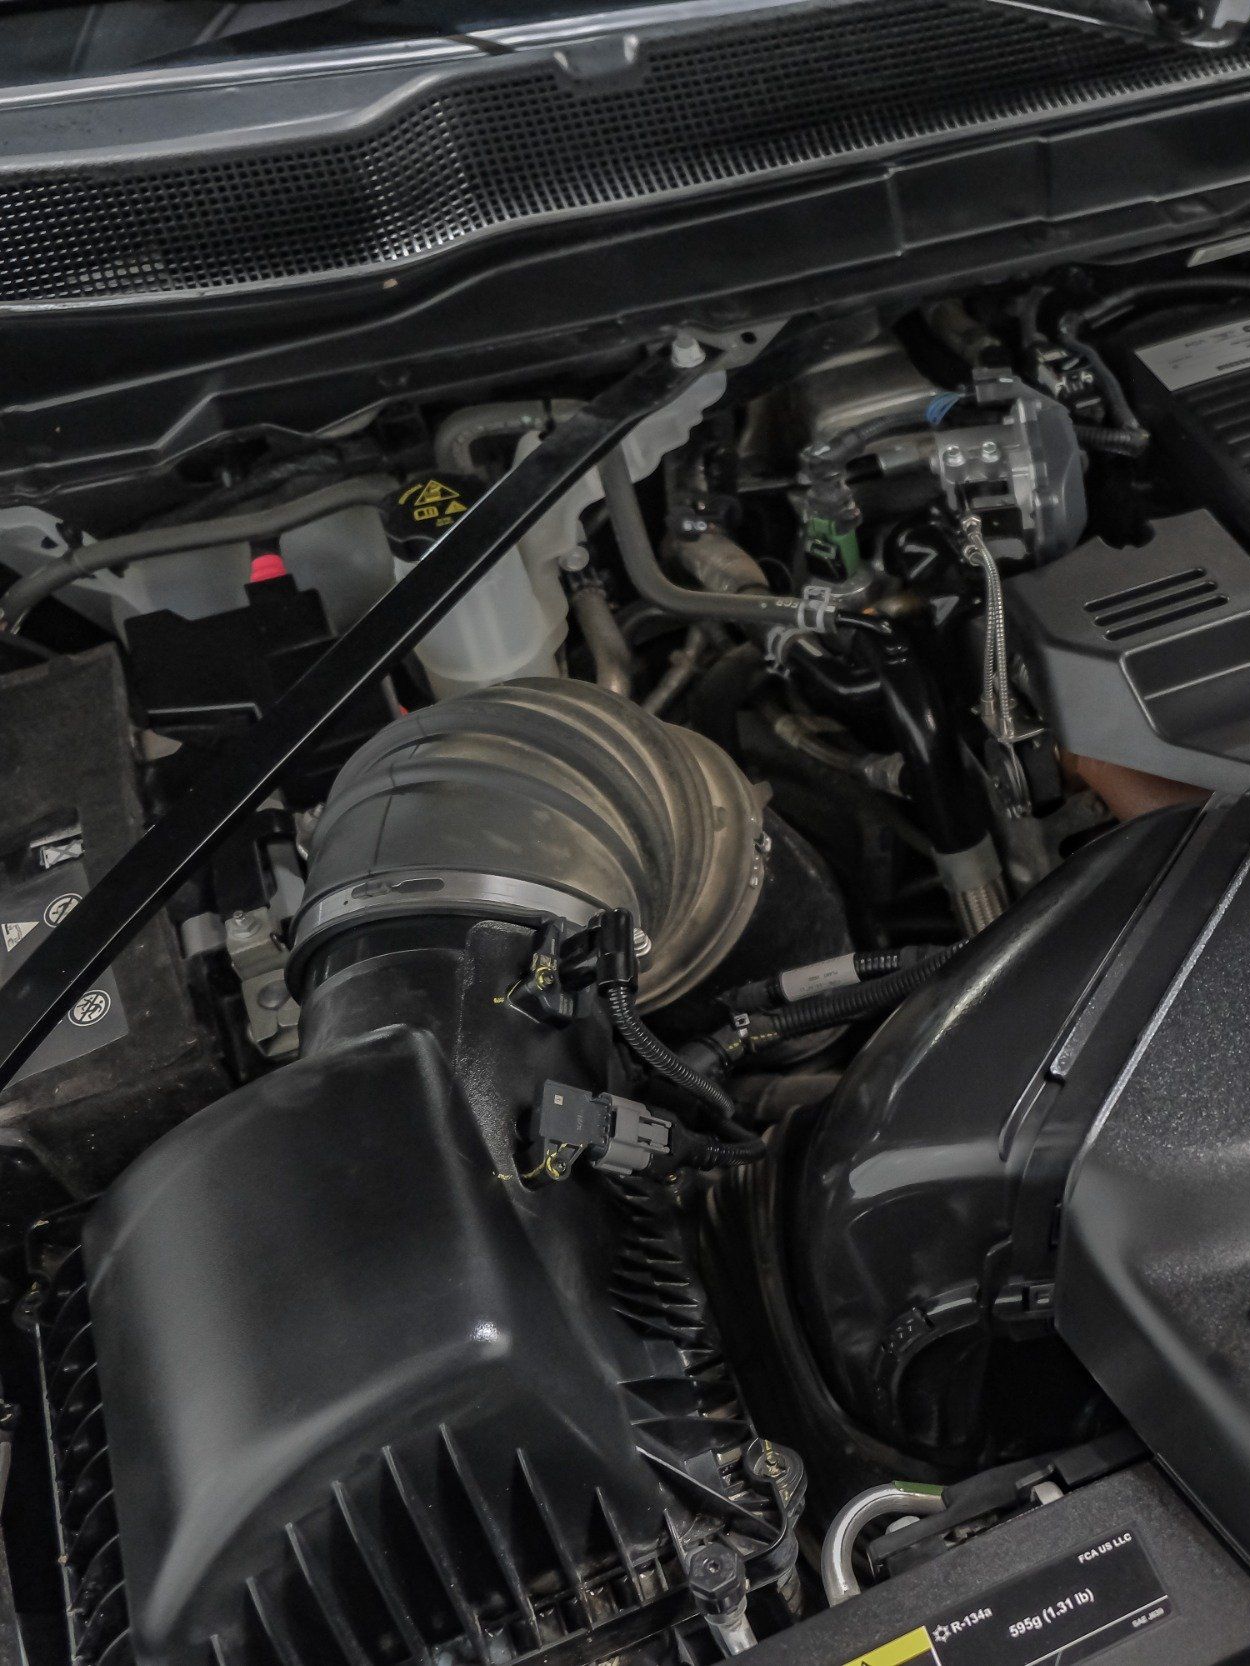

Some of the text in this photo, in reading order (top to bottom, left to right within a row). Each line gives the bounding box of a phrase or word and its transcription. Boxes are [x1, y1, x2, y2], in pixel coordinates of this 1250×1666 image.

[1077, 1532, 1133, 1564] FCA US LLC
[950, 1607, 993, 1634] R-134a
[1009, 1587, 1095, 1638] 595g (1.31 lb)
